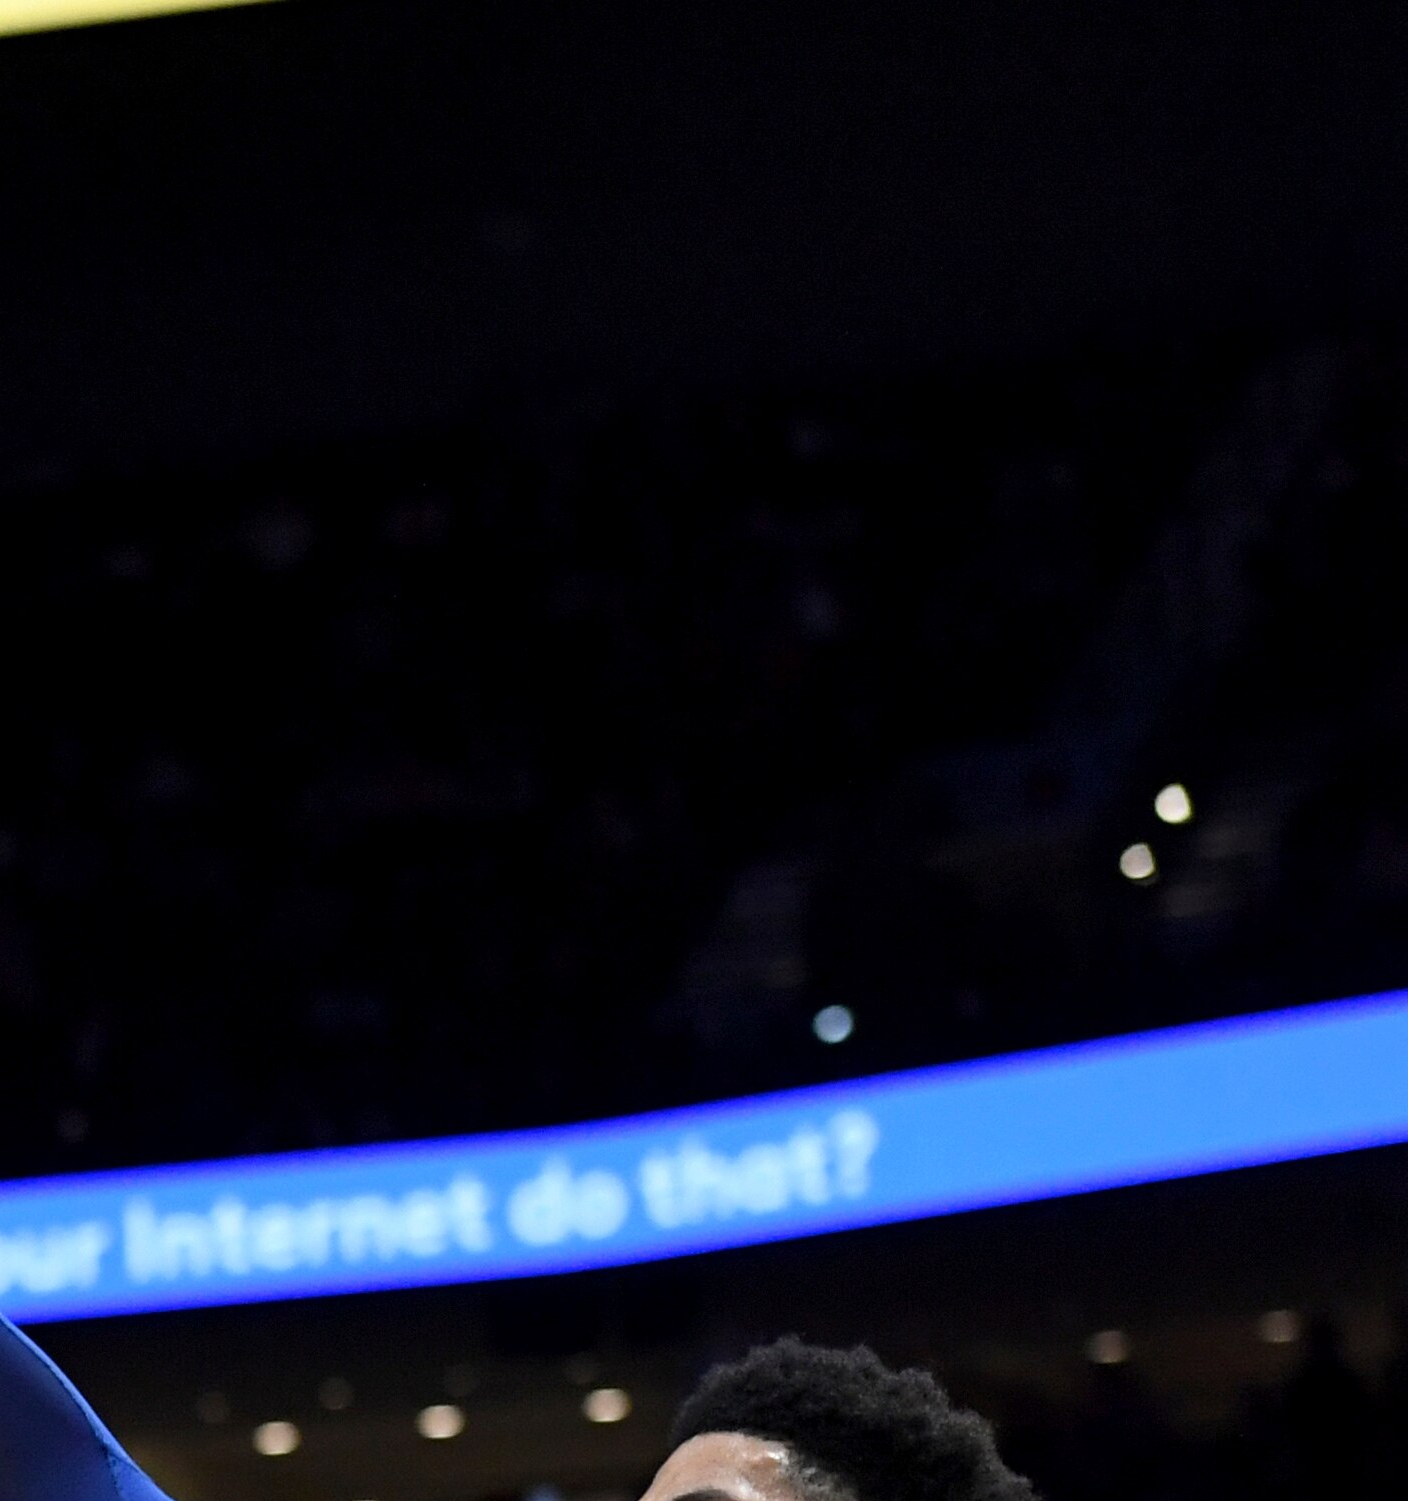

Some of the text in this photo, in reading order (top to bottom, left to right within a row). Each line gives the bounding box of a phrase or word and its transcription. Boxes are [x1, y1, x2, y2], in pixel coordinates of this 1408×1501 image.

[123, 1170, 491, 1286] Internet
[507, 1152, 629, 1248] do
[640, 1108, 881, 1230] that?
